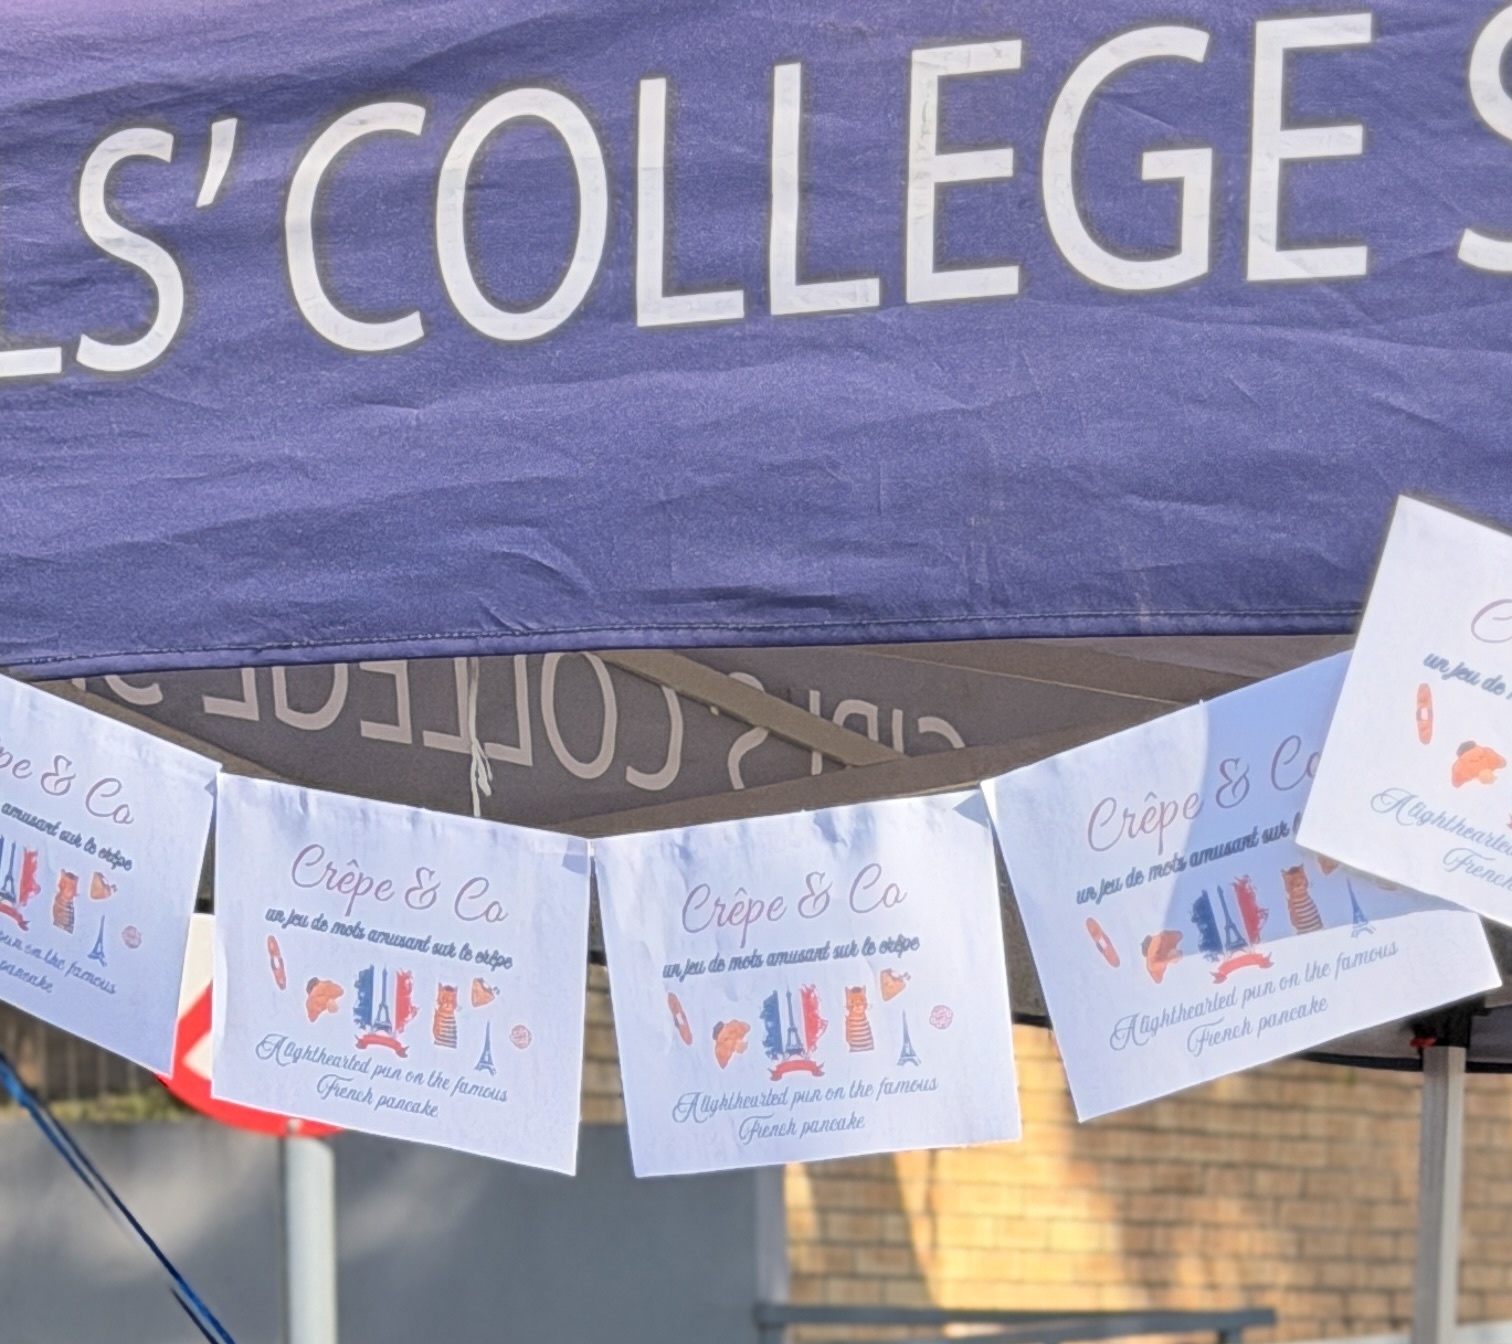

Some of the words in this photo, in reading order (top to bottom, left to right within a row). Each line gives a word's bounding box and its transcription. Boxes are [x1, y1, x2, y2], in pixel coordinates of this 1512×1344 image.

[284, 12, 1373, 354] COLLEGE
[41, 755, 76, 796] &
[85, 777, 134, 824] Co
[1088, 792, 1205, 855] Crêpe
[1215, 758, 1250, 809] &
[1271, 735, 1322, 791] Co
[292, 844, 395, 917] Crêpe
[405, 867, 441, 910] &
[455, 877, 509, 923] Co
[682, 883, 787, 948] Crêpe
[798, 871, 833, 918] &
[850, 863, 908, 913] Co
[1305, 962, 1330, 983] the
[1334, 942, 1398, 980] famous
[1187, 1017, 1254, 1057] French
[1256, 995, 1328, 1038] pancake
[317, 1074, 372, 1105] French
[375, 1093, 438, 1118] pancake
[427, 1070, 449, 1090] the
[450, 1076, 507, 1102] famous
[850, 1080, 873, 1099] the
[875, 1076, 938, 1101] famous
[739, 1113, 797, 1145] French
[799, 1112, 865, 1139] pancake
